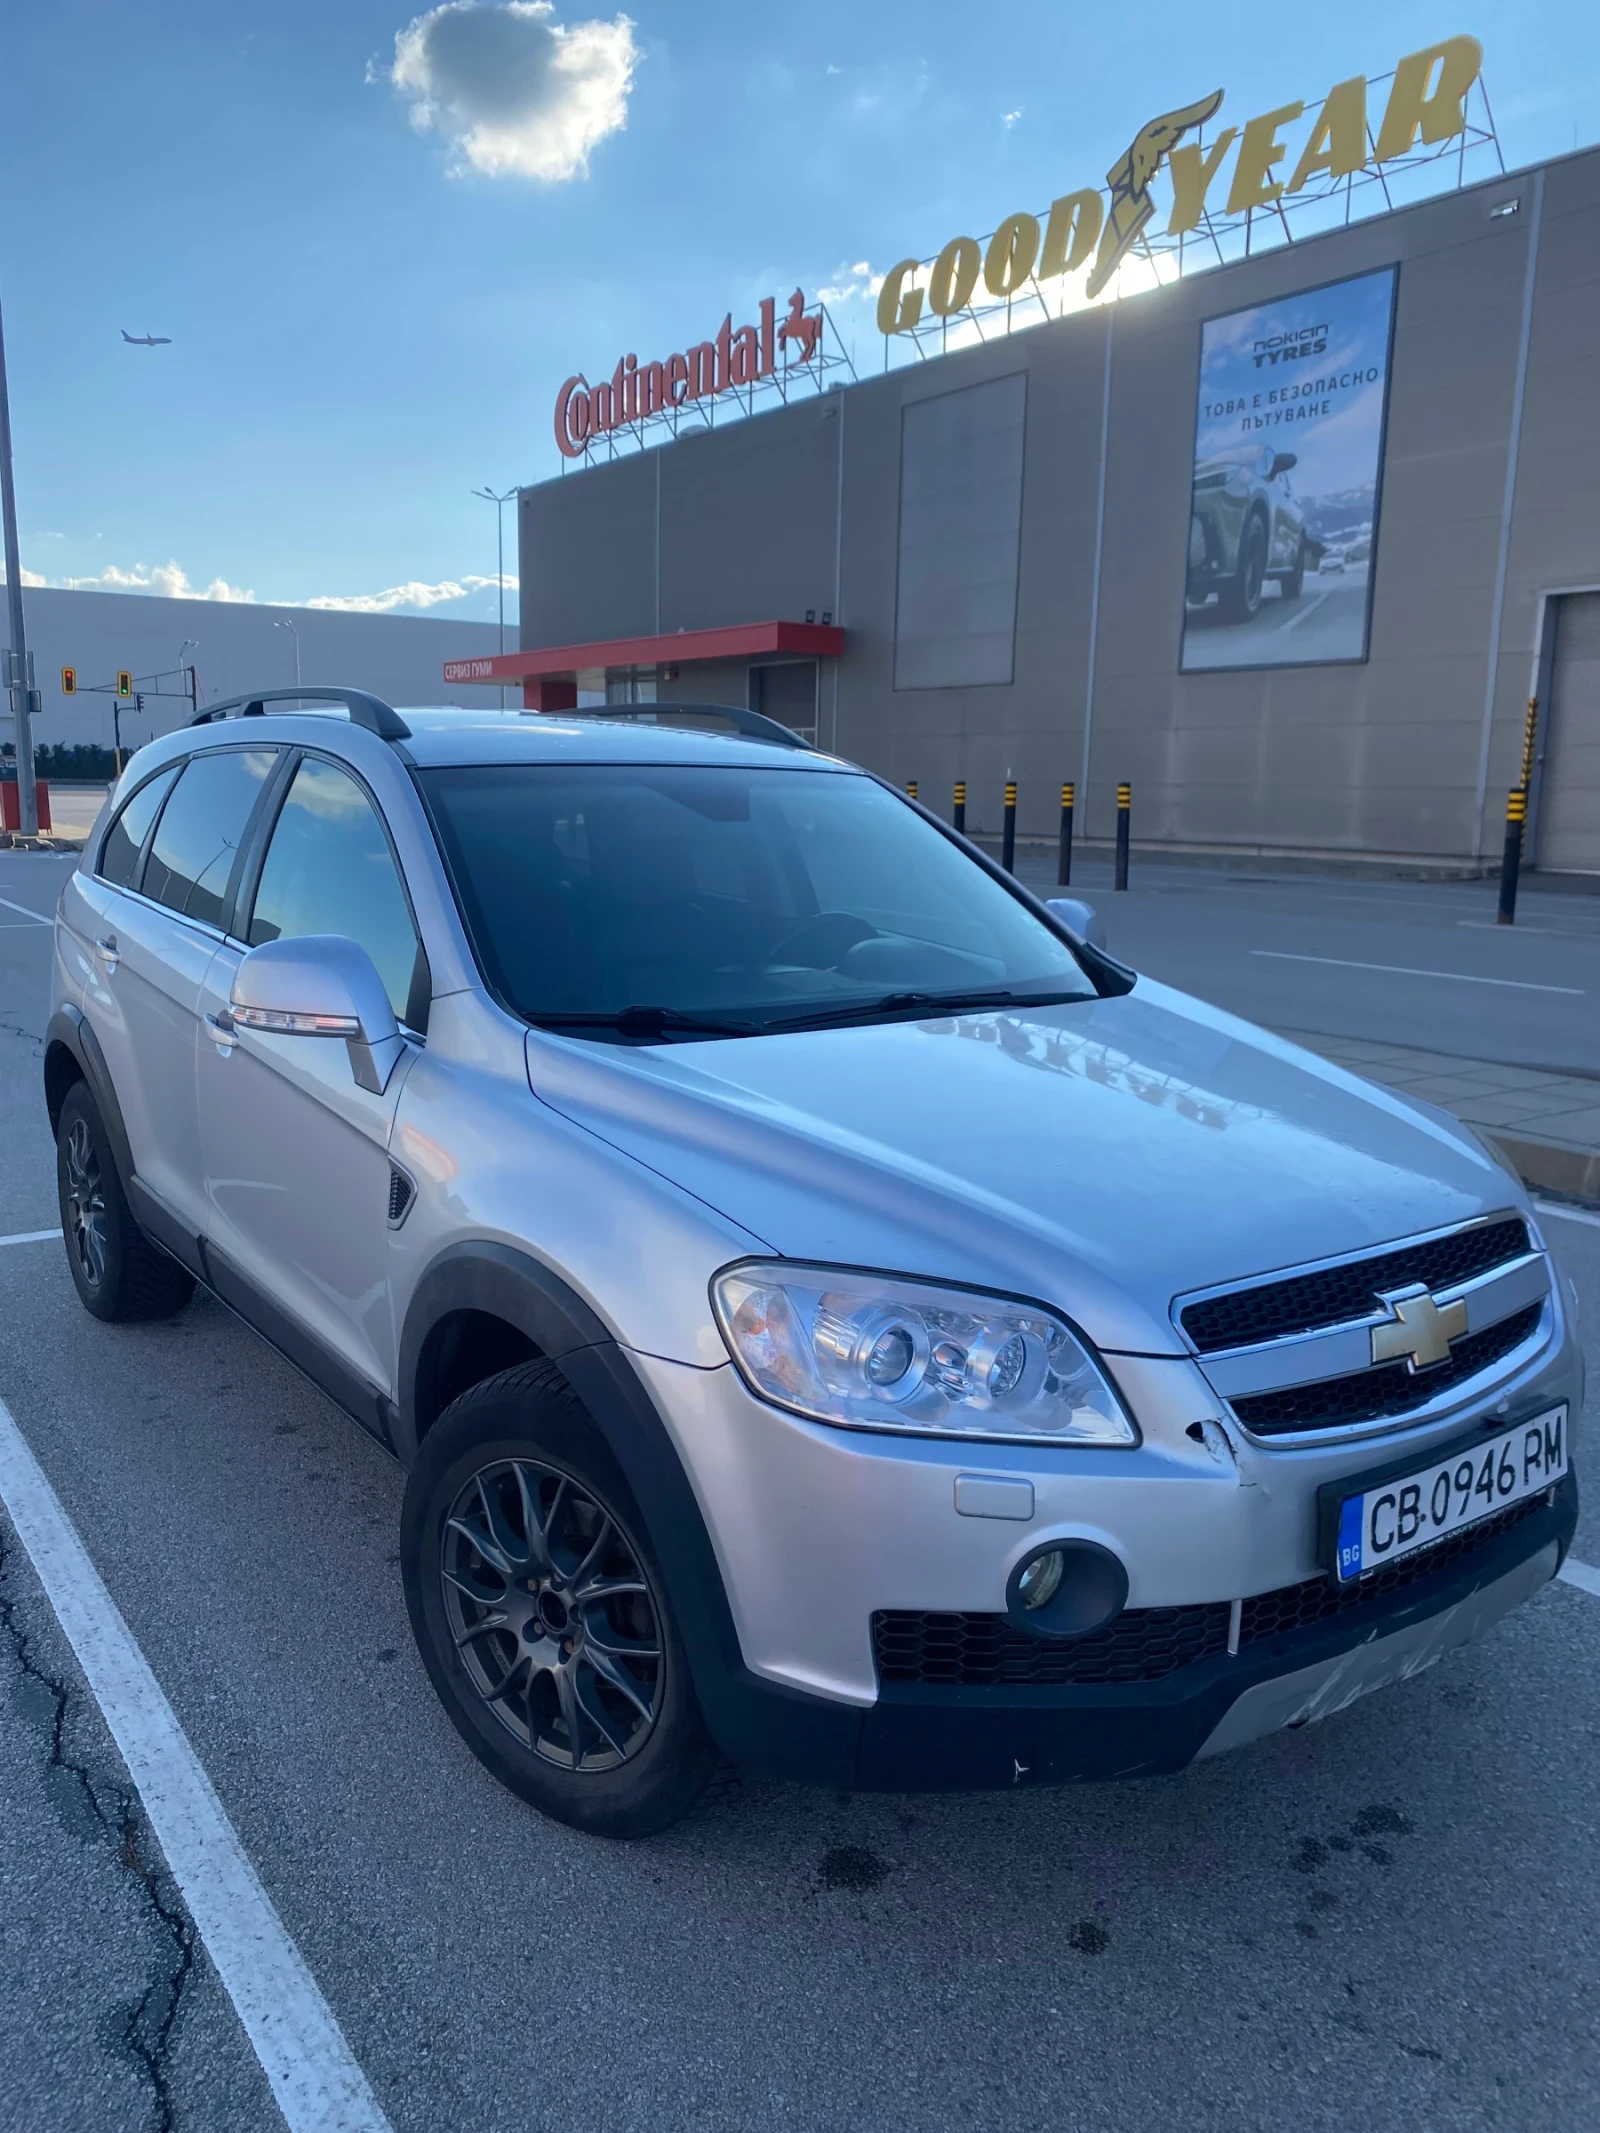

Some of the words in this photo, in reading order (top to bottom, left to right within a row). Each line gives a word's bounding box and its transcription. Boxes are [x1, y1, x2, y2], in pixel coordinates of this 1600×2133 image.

[1252, 338, 1328, 368] TYRES
[554, 296, 776, 458] Continental
[1203, 396, 1245, 418] ТОВА
[1252, 393, 1262, 409] Е
[1268, 366, 1379, 405] БЕЗОПАСНО
[1241, 398, 1331, 432] ПЪТУВАНЕ
[445, 663, 470, 679] СЕРВИЗ
[471, 660, 492, 677] ГУМИ
[1342, 1544, 1360, 1568] BG
